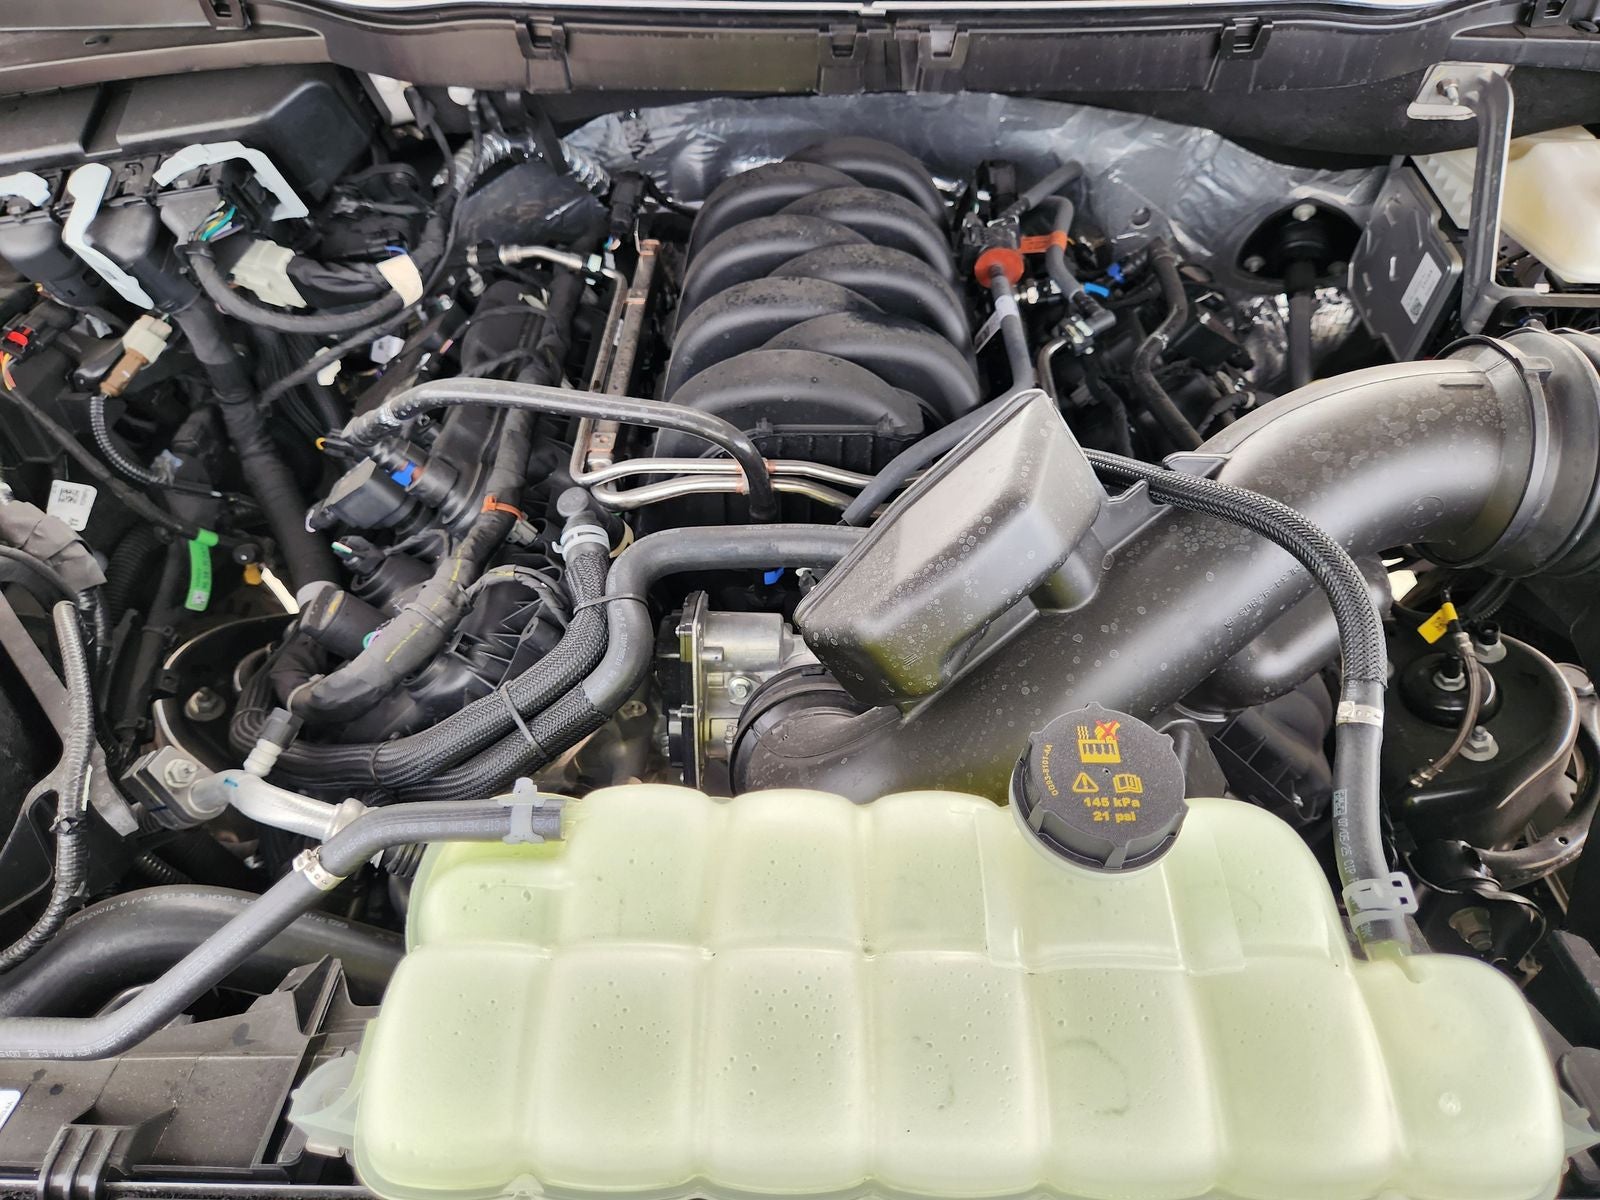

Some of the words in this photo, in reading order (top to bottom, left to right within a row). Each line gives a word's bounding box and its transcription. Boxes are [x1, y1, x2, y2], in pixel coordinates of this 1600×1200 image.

[1083, 797, 1109, 808] 145
[1113, 797, 1141, 808] kPa
[1093, 812, 1110, 822] 21
[1115, 811, 1137, 823] psi
